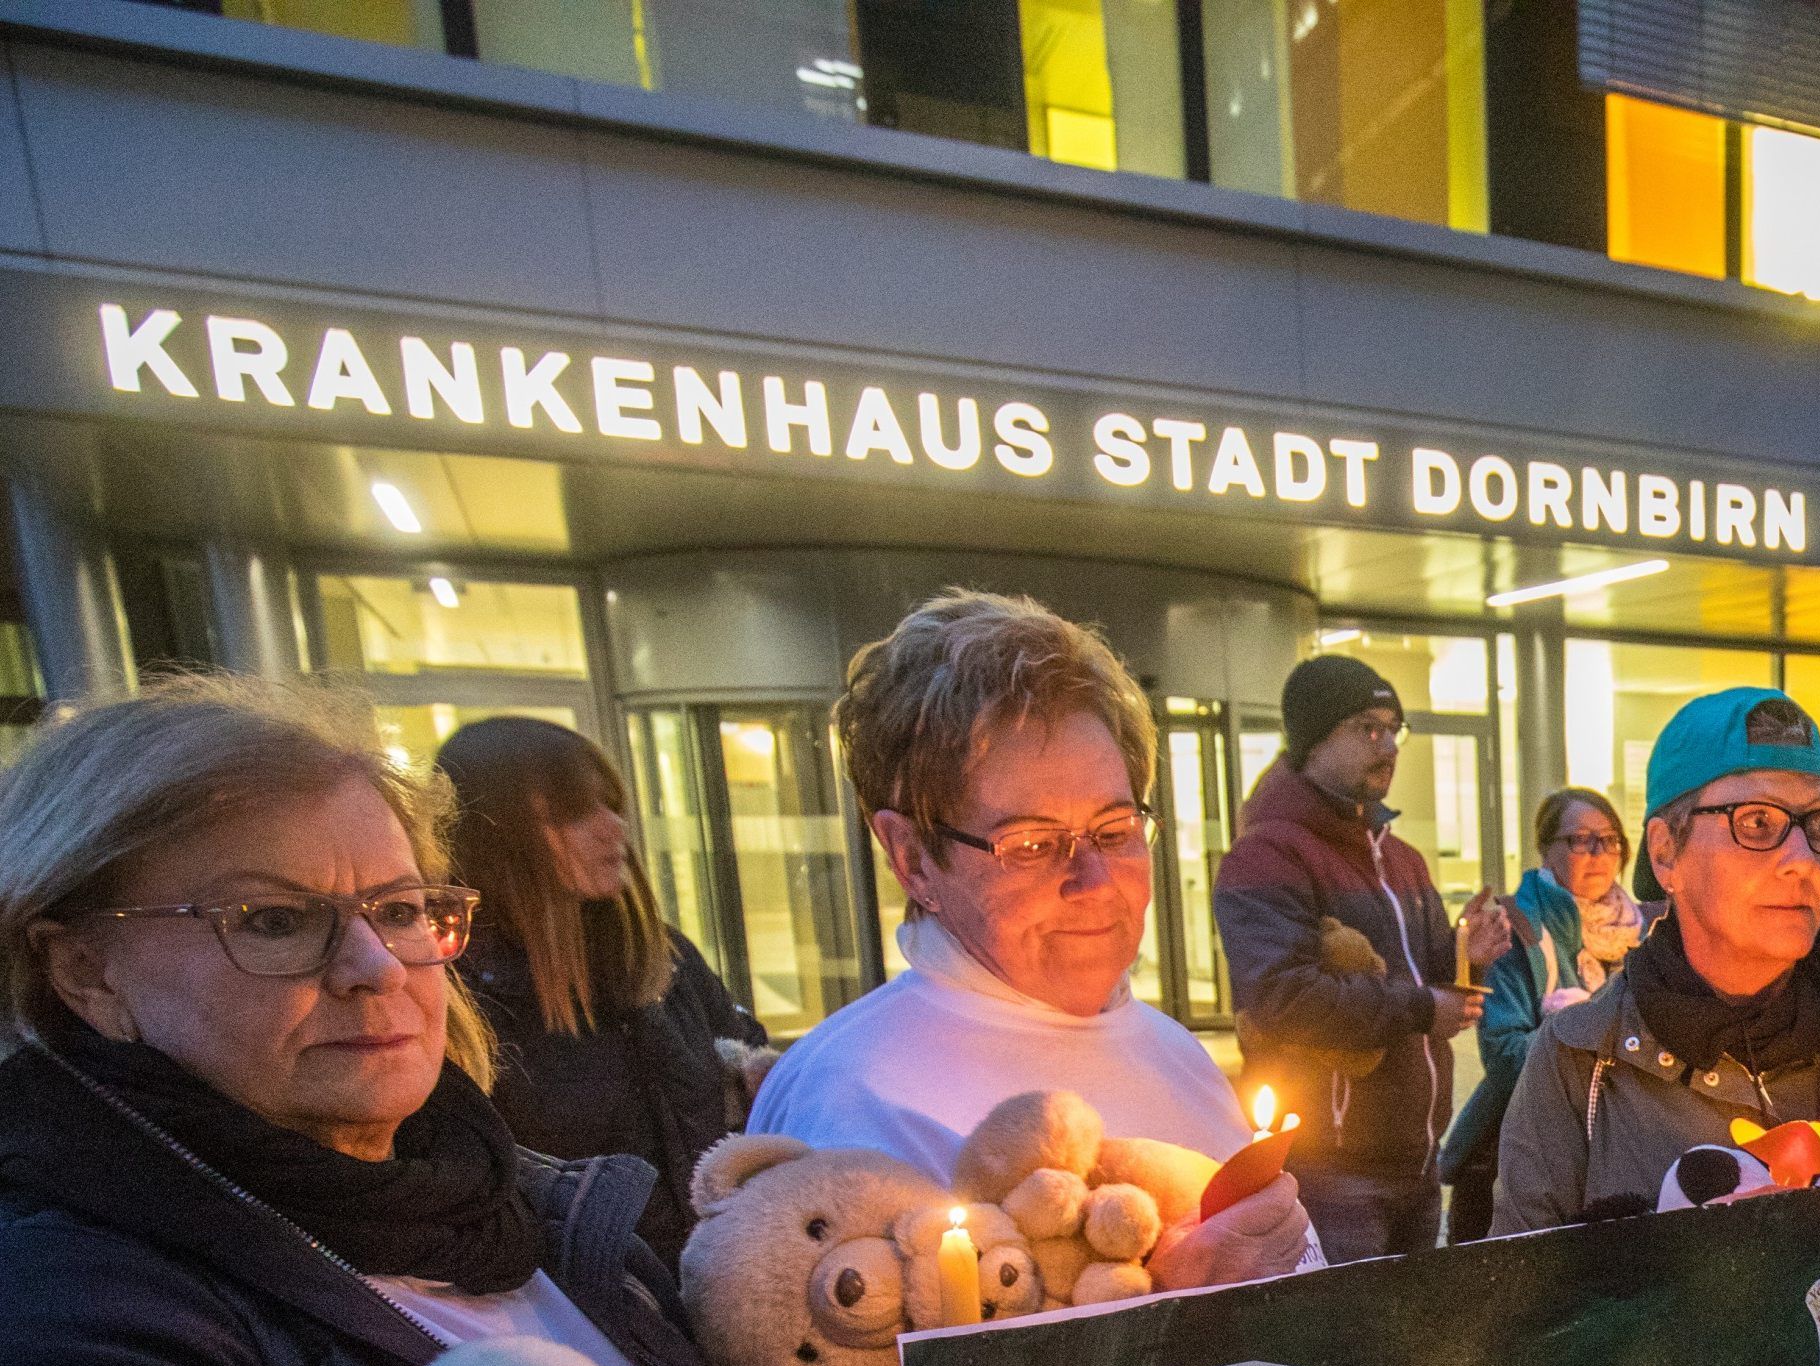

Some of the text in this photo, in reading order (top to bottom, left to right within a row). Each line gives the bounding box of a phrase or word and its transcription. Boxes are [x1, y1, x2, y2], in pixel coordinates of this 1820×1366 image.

[100, 302, 1806, 552] KRANKENHAUS STADT DORNBIRN
